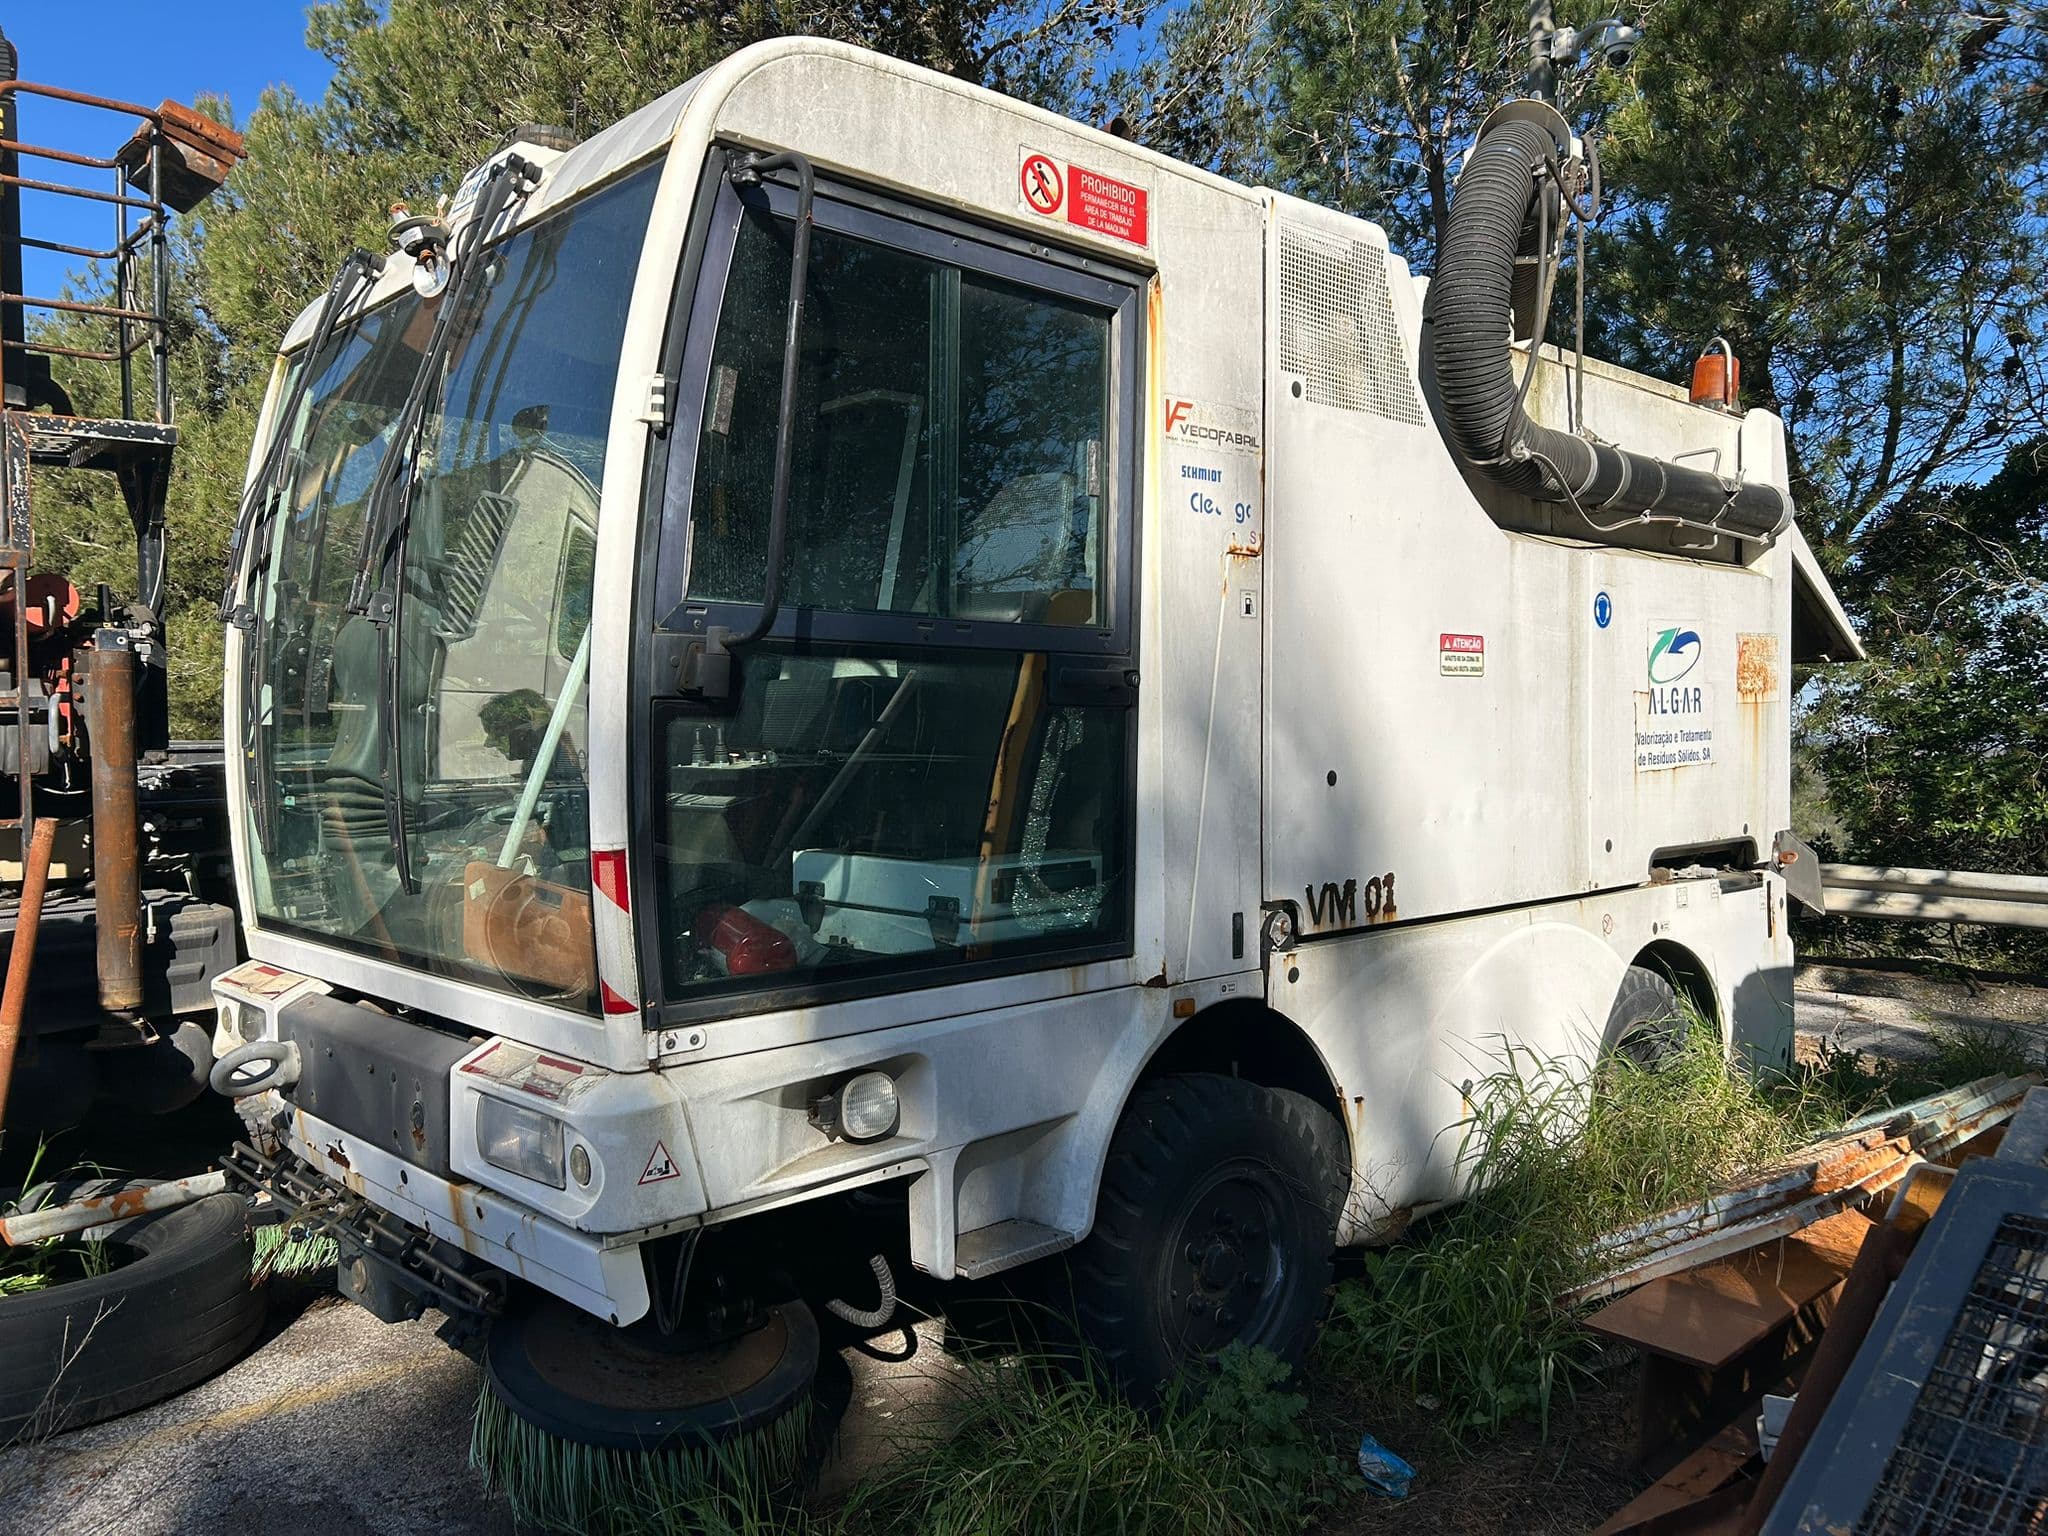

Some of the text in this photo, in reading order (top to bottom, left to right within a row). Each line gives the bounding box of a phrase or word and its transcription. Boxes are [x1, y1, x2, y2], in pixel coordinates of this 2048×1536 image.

[1081, 173, 1136, 205] PROHIBIDO
[1080, 191, 1136, 217] PERMANECER EN EL
[1088, 216, 1096, 226] DE
[1097, 219, 1104, 229] LA
[1100, 209, 1108, 219] DE
[1109, 211, 1132, 227] TRABAJO
[1180, 423, 1260, 448] VECOFABRIL
[1181, 465, 1222, 482] SCHMIDT
[1453, 637, 1482, 650] ATENÇÃO
[1636, 728, 1713, 748] Valorização e Tratamento
[1638, 753, 1646, 766] de
[1648, 751, 1676, 765] Resíduos
[1703, 747, 1711, 760] SA
[1305, 871, 1397, 925] VM 01
